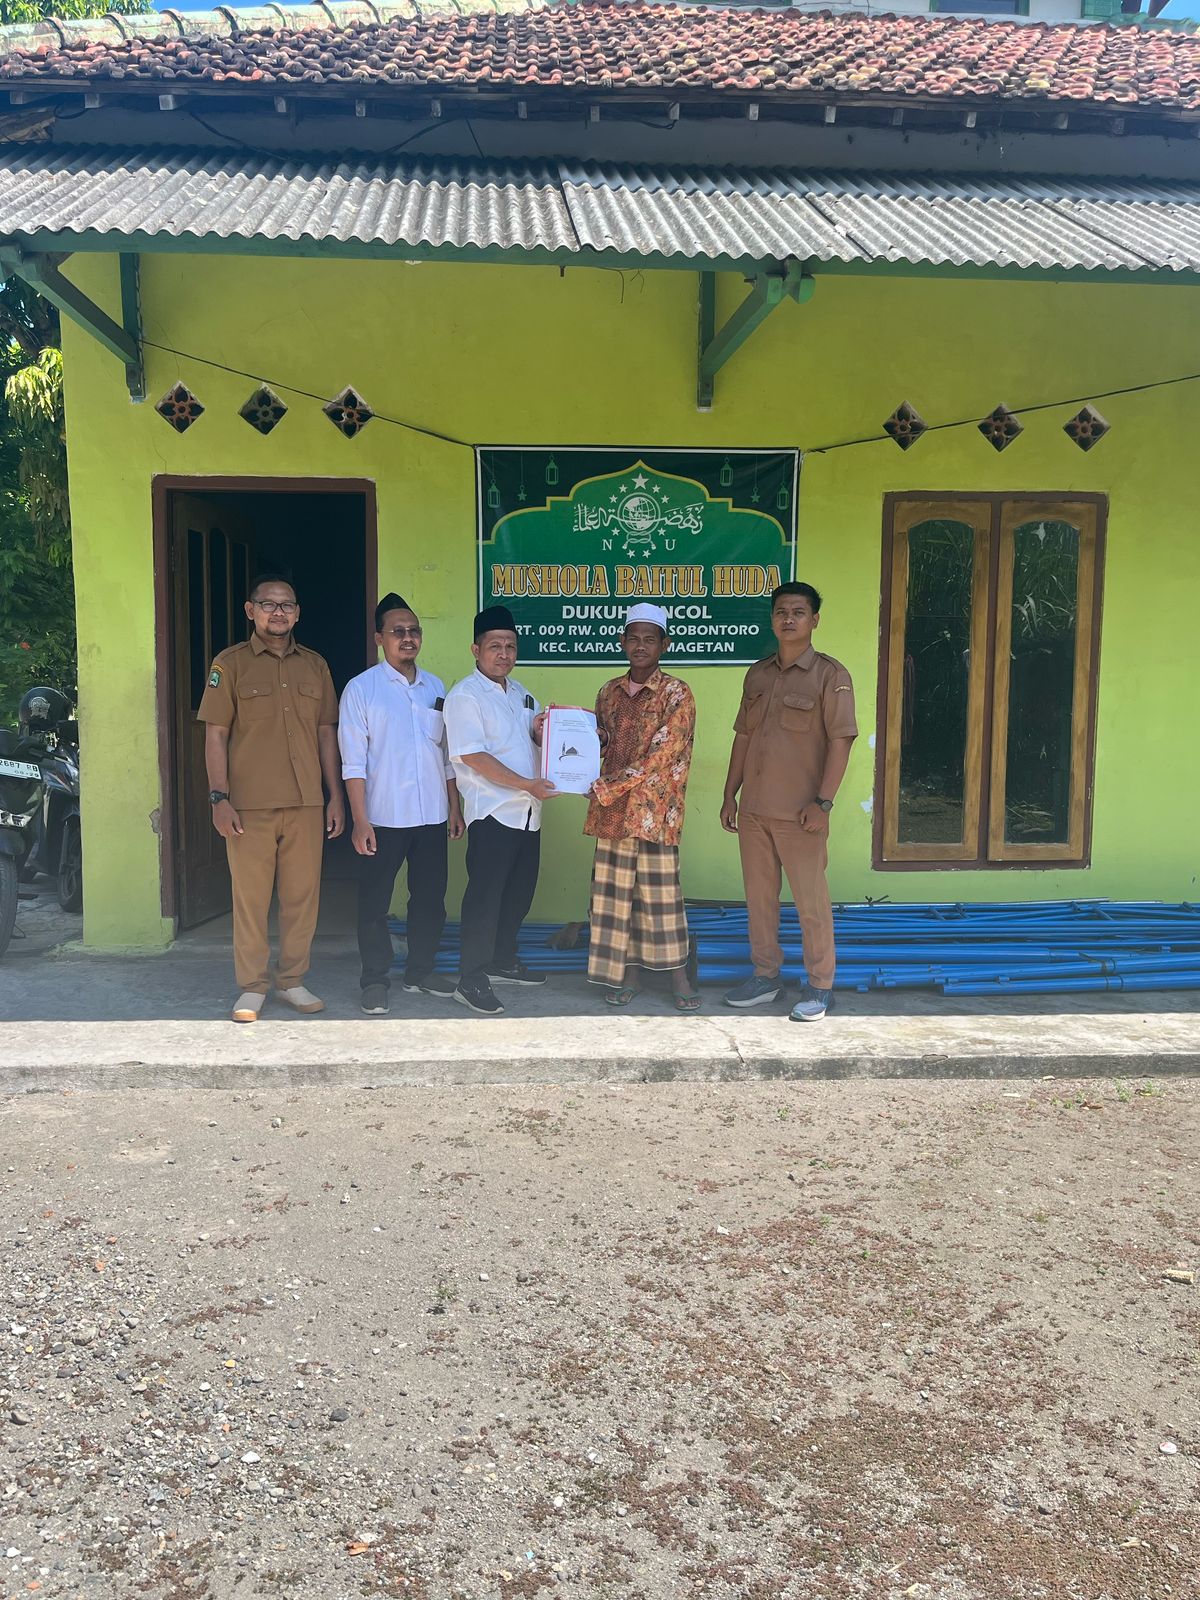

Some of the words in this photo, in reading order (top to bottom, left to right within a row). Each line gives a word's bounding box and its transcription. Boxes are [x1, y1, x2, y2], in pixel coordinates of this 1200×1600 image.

[602, 539, 612, 551] N
[665, 539, 676, 551] U
[491, 564, 610, 597] MUSHOLA
[614, 564, 707, 597] BAITUL
[712, 564, 781, 597] HUDA
[562, 605, 630, 619] DUKUH
[515, 624, 535, 636] RT.
[539, 624, 564, 636] 009
[568, 624, 595, 636] RW.
[600, 624, 625, 636] 004
[668, 624, 760, 636] SOBONTORO
[539, 641, 570, 653] KEC.
[574, 641, 622, 653] KARAS
[667, 641, 735, 653] MAGETAN
